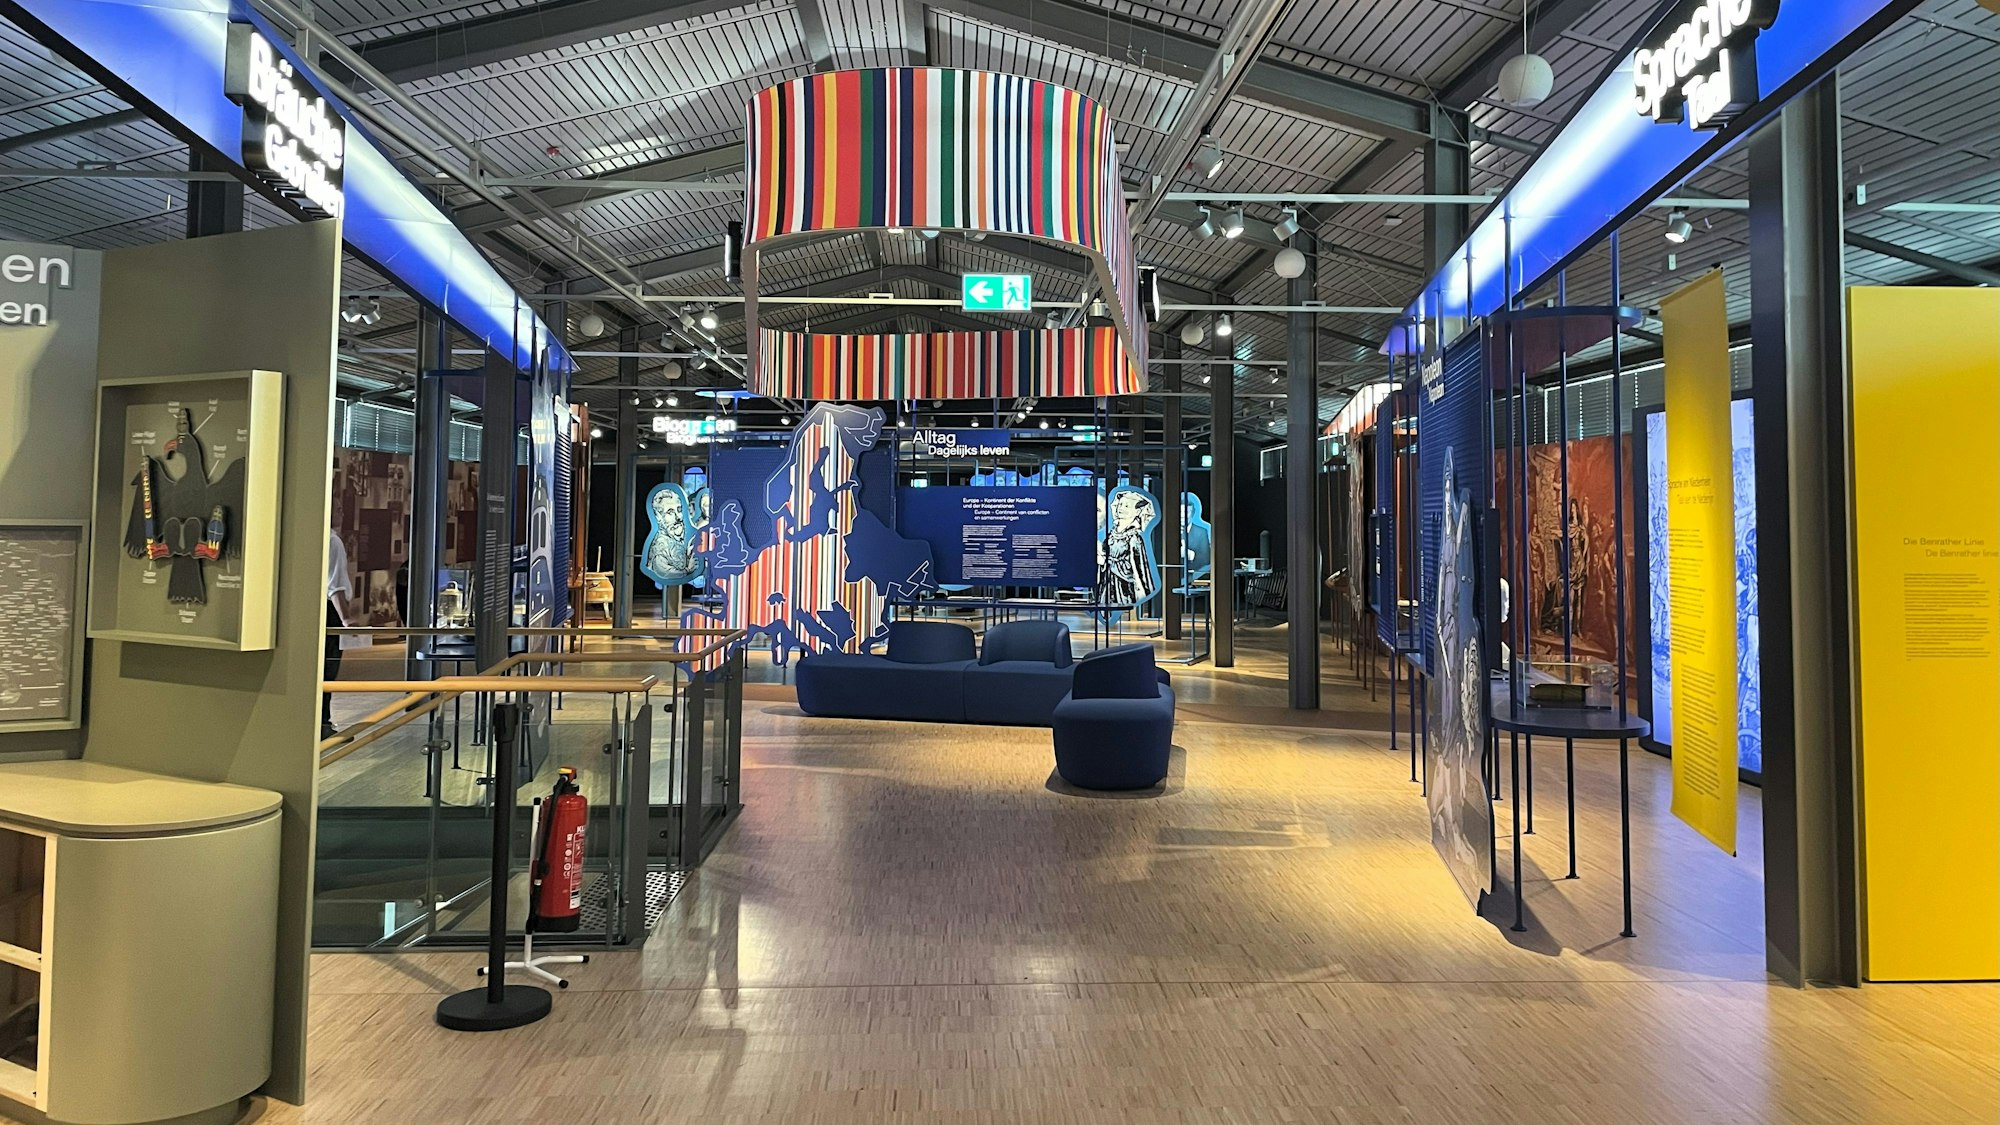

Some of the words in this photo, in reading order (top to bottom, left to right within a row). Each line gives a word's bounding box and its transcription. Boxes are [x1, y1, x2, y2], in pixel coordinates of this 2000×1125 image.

[248, 31, 343, 170] Bräuche
[912, 429, 956, 447] Alltag
[928, 444, 978, 458] Dagelijks
[979, 444, 1010, 456] leven
[1903, 537, 1918, 545] Die
